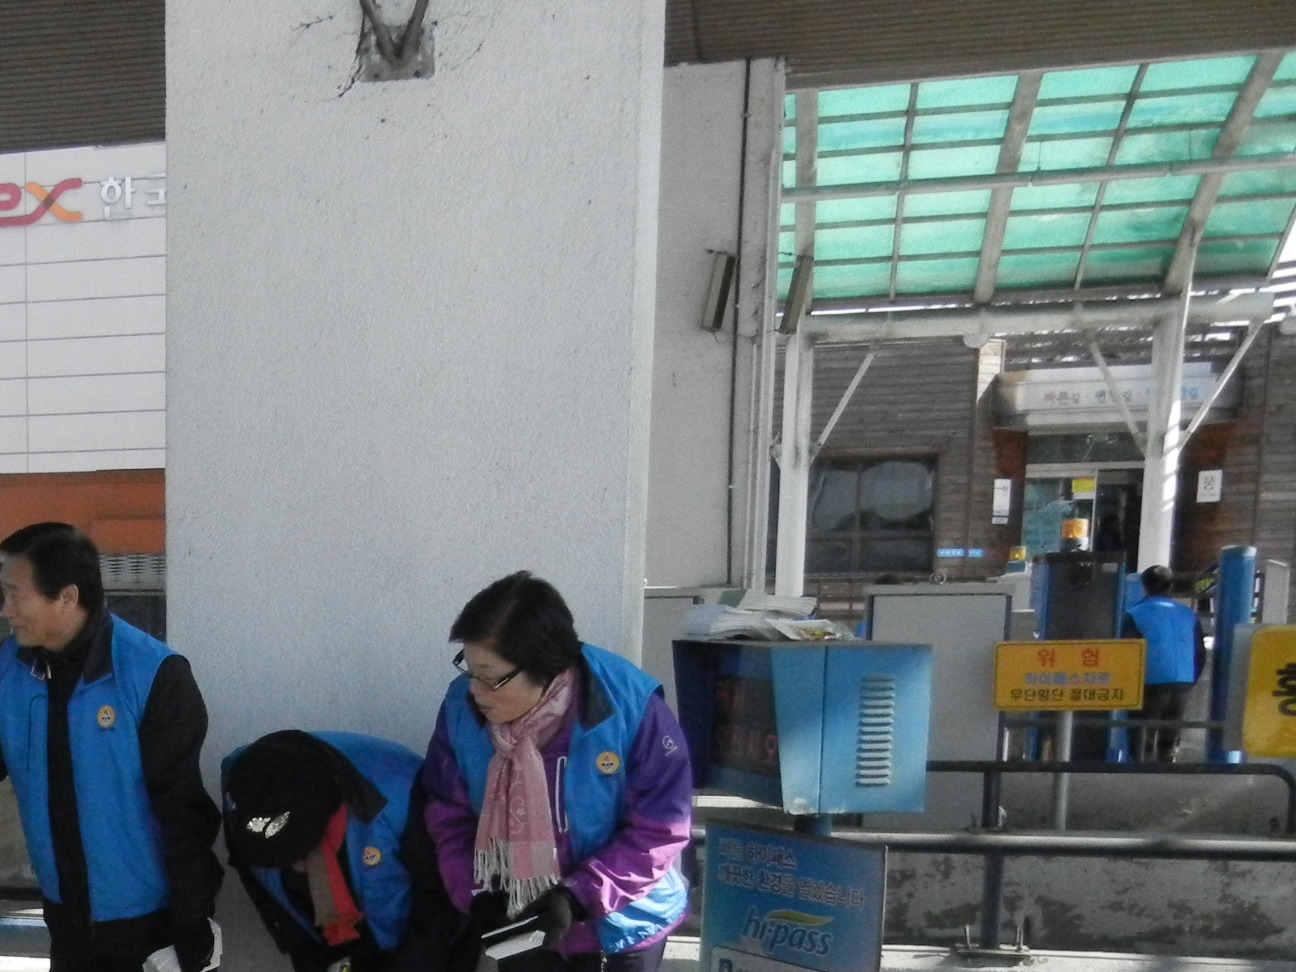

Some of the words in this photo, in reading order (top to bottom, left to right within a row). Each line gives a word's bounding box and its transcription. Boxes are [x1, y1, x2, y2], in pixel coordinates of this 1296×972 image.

[1010, 688, 1064, 701] 무단횡단
[1070, 688, 1124, 701] 절대금지
[745, 842, 797, 869] 하이패스
[757, 870, 796, 898] 환경을
